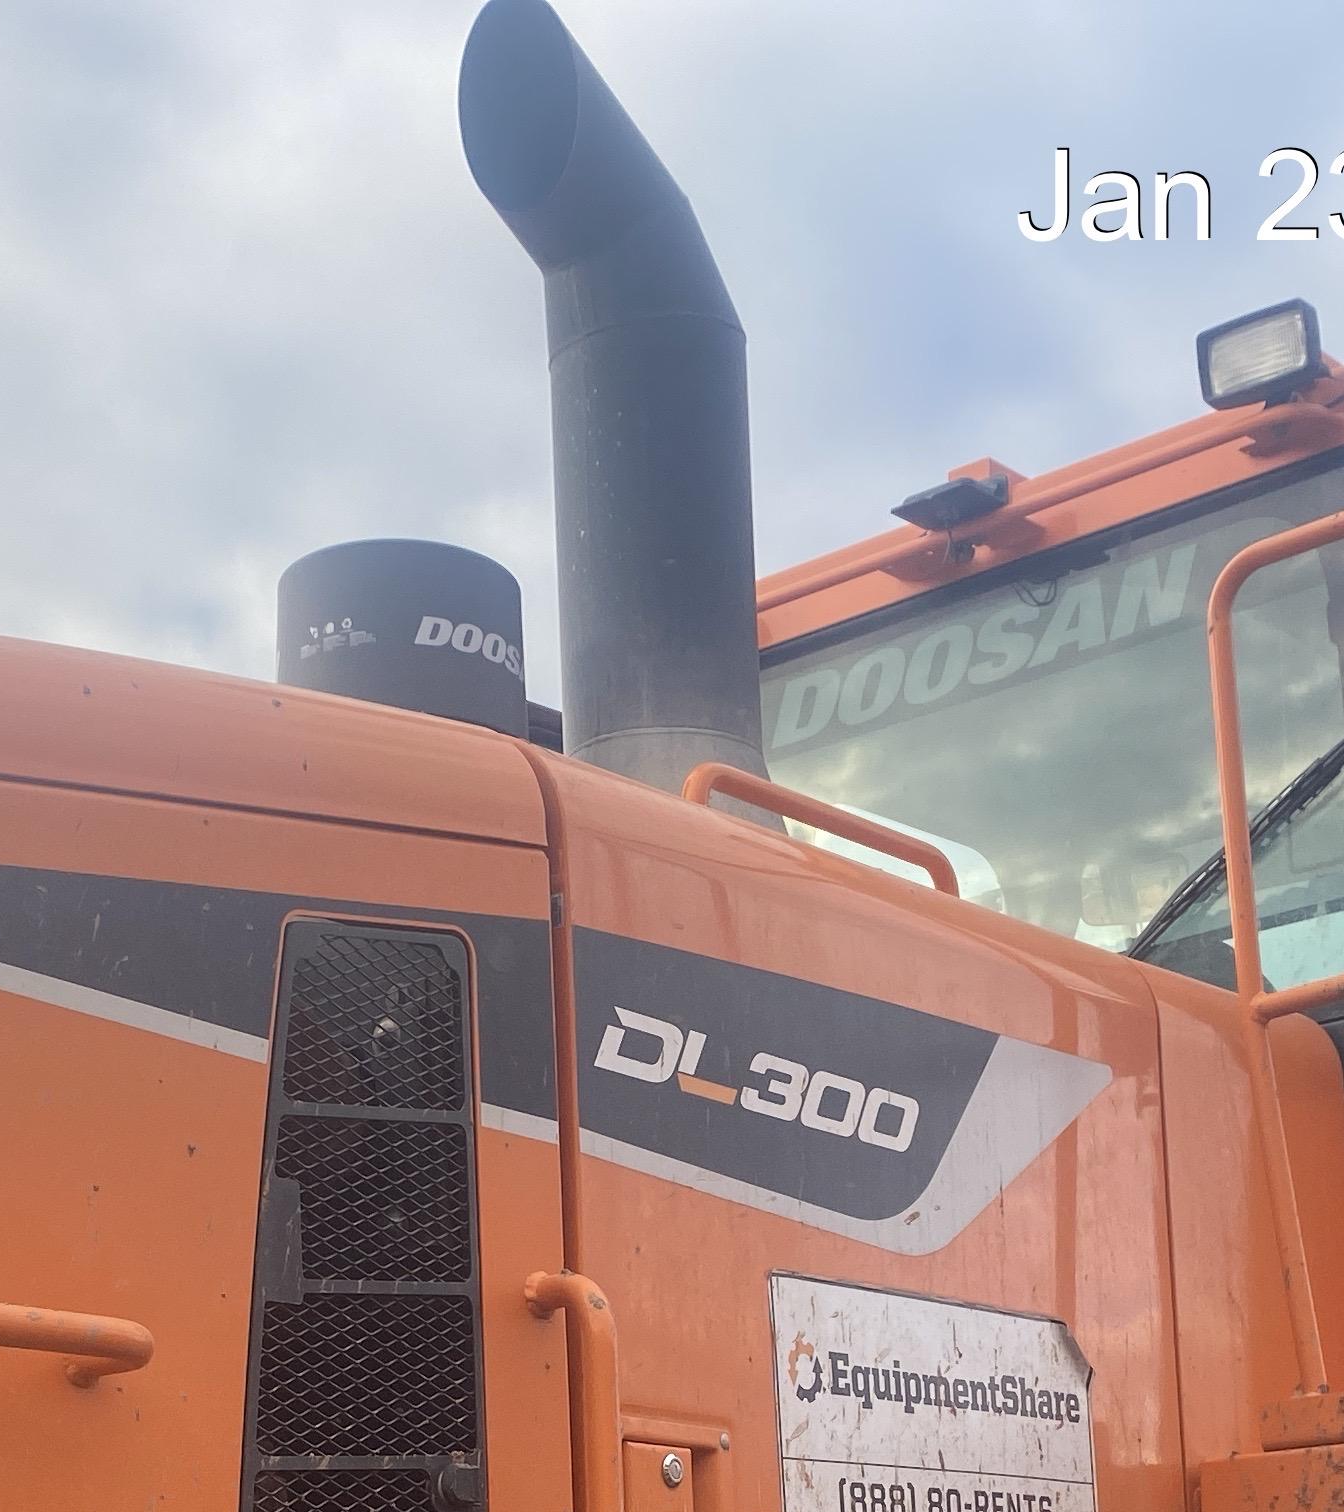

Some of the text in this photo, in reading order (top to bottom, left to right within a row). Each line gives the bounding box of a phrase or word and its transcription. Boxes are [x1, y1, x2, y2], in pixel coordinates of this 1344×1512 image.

[414, 616, 524, 680] DOOS
[772, 543, 1197, 748] DOOSAN
[593, 1006, 919, 1153] DL300
[829, 1350, 1080, 1423] EquipmentShare
